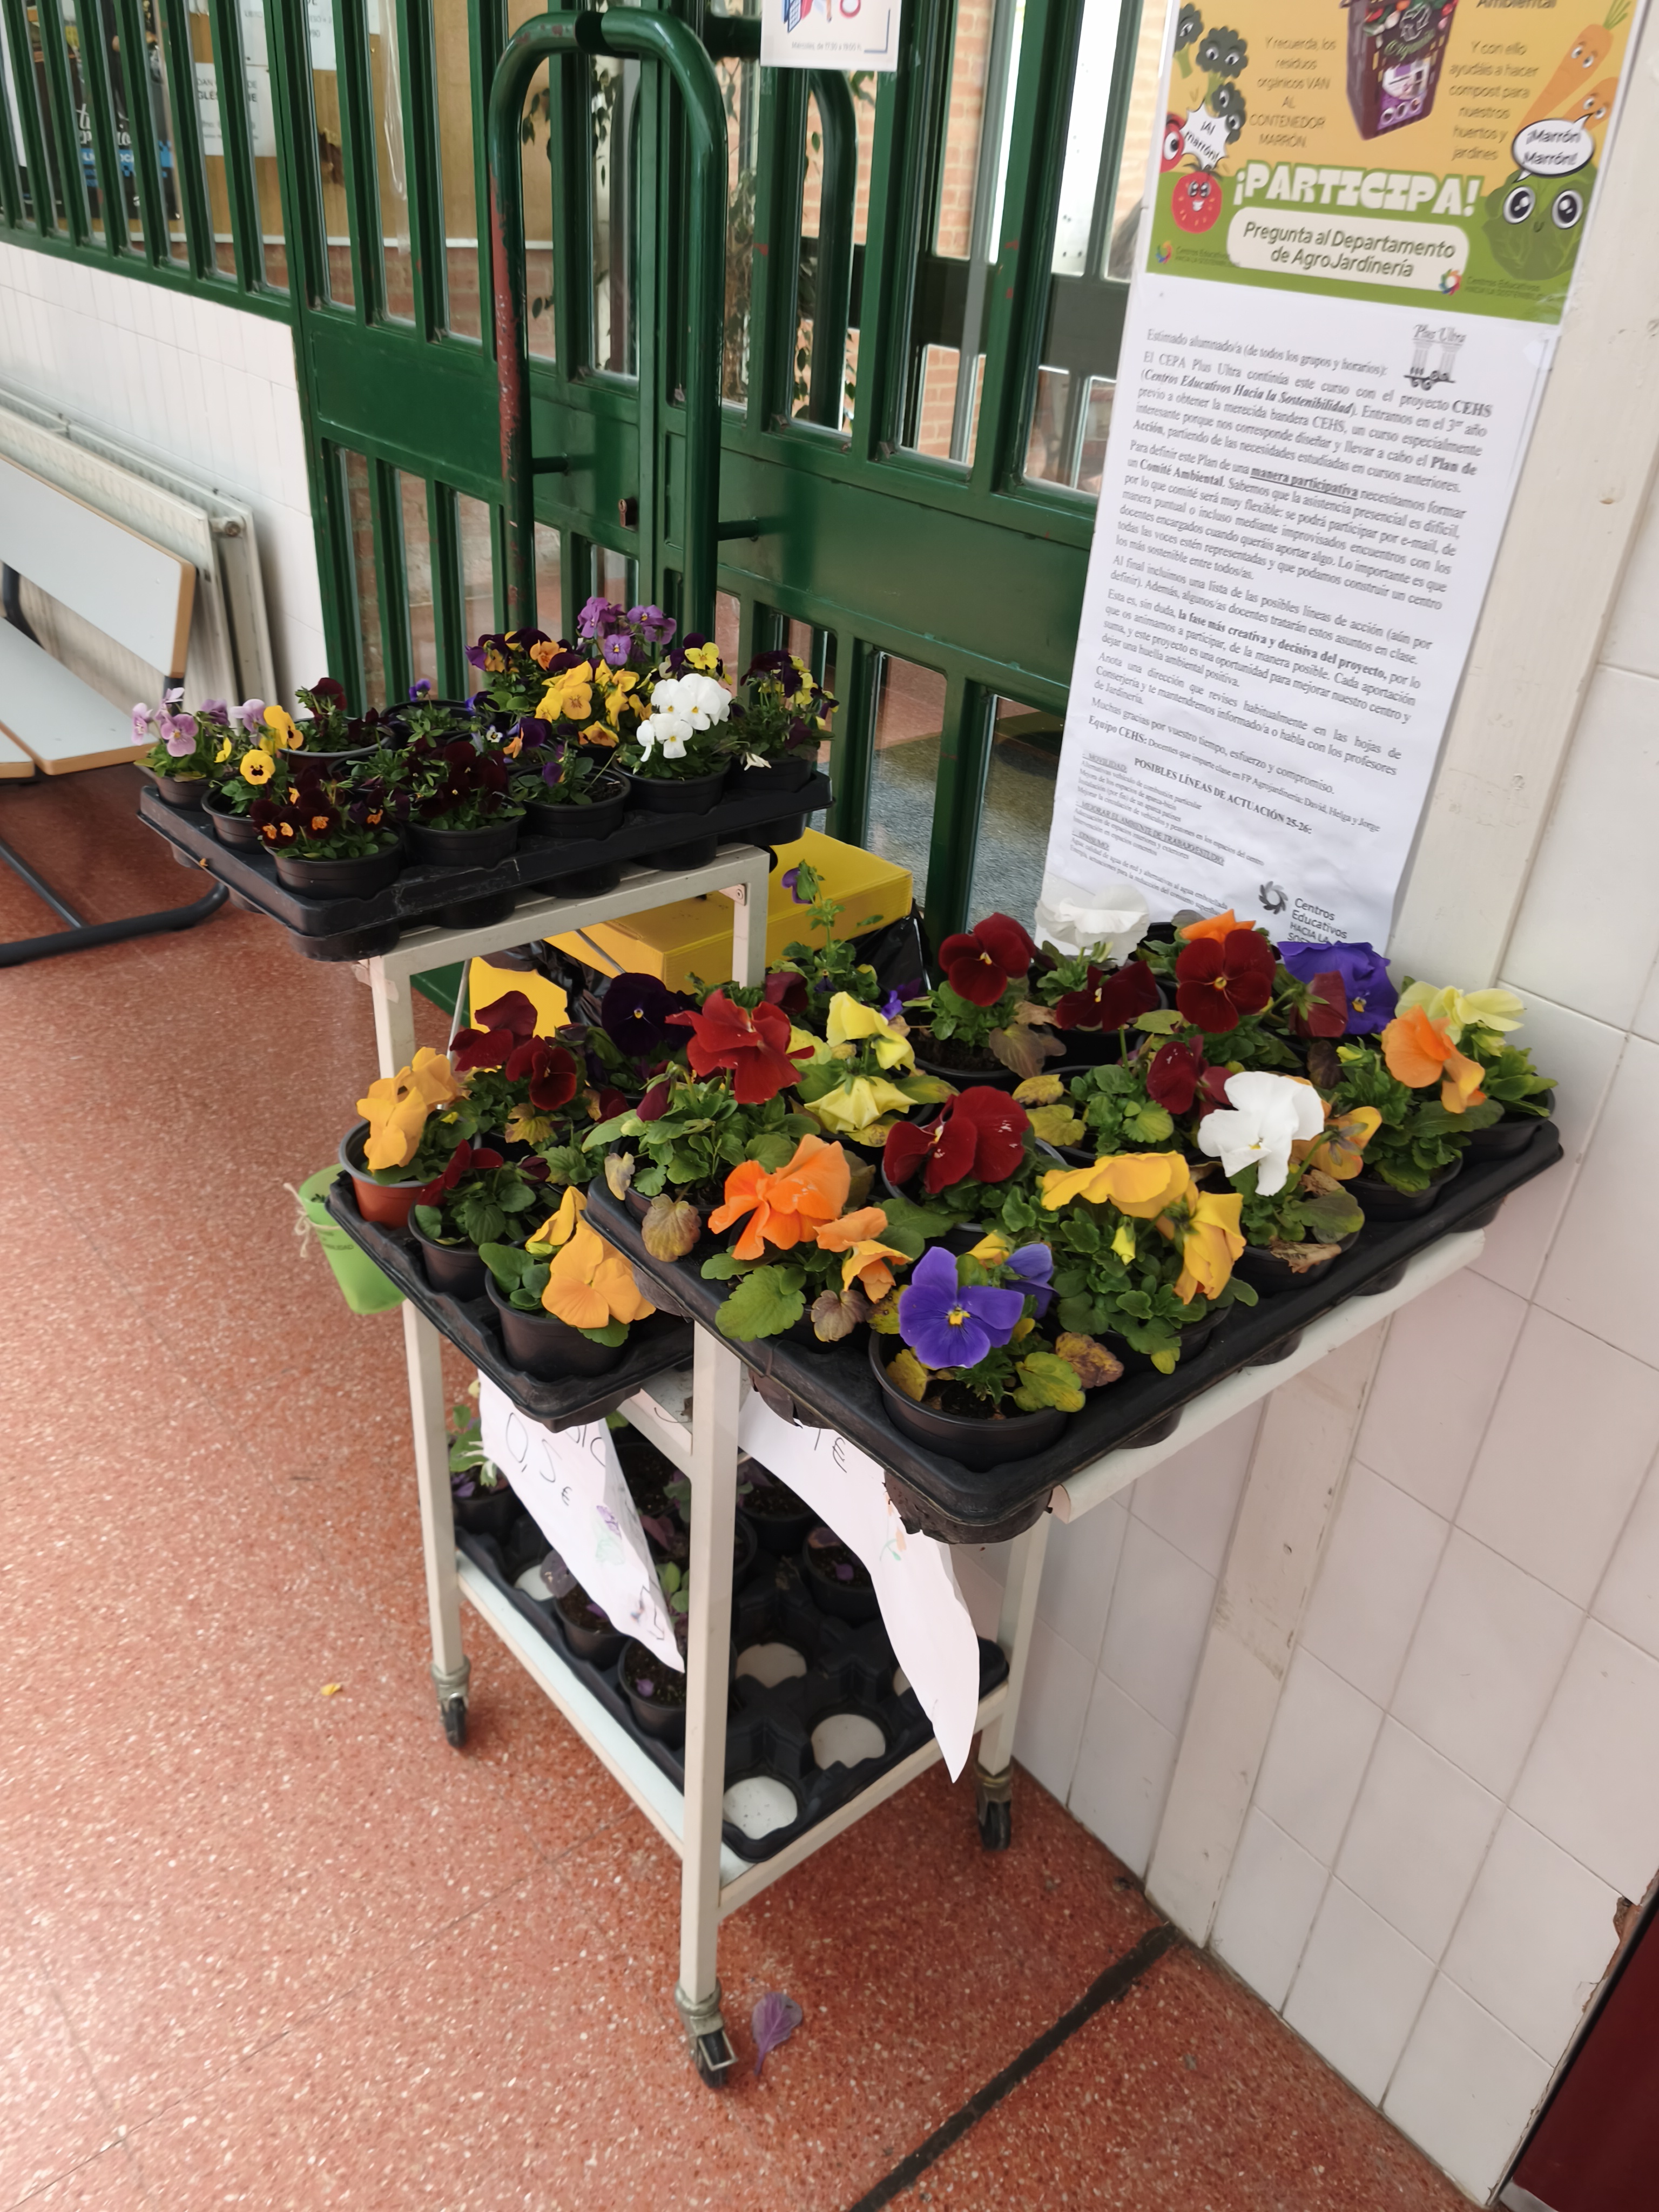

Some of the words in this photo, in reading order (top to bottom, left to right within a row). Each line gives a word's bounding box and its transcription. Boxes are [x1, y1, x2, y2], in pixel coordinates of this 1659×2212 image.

[1481, 43, 1503, 55] con
[1504, 64, 1539, 77] hacer
[1306, 77, 1331, 90] VAN
[1449, 85, 1501, 99] compost
[1501, 87, 1530, 100] para
[1281, 96, 1296, 109] AL
[1459, 107, 1510, 119] nuestros
[1249, 113, 1325, 129] CONTENEDOR
[1453, 125, 1498, 139] huertos
[1451, 146, 1500, 161] jardines
[1233, 164, 1481, 217] ¡PARTICIPA!
[1243, 221, 1313, 245] Pregunta
[1314, 228, 1332, 246] al
[1331, 230, 1456, 259] Departamento
[1271, 245, 1290, 264] de
[1291, 248, 1415, 278] AgroJardinería
[1413, 323, 1436, 340] Plus
[1143, 350, 1155, 363] El
[1158, 353, 1186, 368] CEPA
[1191, 358, 1212, 373] Plus
[1217, 362, 1242, 378] Ultra
[1246, 370, 1290, 386] continúa
[1294, 378, 1316, 390] este
[1320, 382, 1350, 395] curso
[1355, 388, 1377, 400] con
[1381, 389, 1395, 402] el
[1399, 395, 1450, 411] proyecto
[1451, 400, 1493, 418] CEHS
[1180, 375, 1231, 394] Educativos
[1232, 383, 1265, 400] Hacia
[1264, 388, 1278, 402] la
[1361, 405, 1413, 425] Entramos
[1432, 417, 1446, 430] el
[1464, 423, 1487, 437] año
[1130, 439, 1149, 454] Para
[1149, 444, 1178, 460] definir
[1178, 453, 1196, 463] este
[1197, 454, 1218, 468] Plan
[1218, 458, 1232, 471] de
[1232, 464, 1250, 475] una
[1250, 468, 1290, 486] manera
[1290, 476, 1359, 500] participativa
[1360, 490, 1425, 511] necesitamos
[1427, 501, 1467, 519] formar
[1108, 588, 1125, 602] Esta
[1139, 598, 1152, 610] sin
[1178, 609, 1188, 621] la
[1188, 612, 1207, 626] fase
[1207, 621, 1226, 632] más
[1228, 627, 1267, 644] creativa
[1277, 639, 1318, 659] decisiva
[1319, 651, 1338, 664] del
[1388, 673, 1409, 685] por
[1409, 676, 1421, 689] lo
[1092, 697, 1122, 715] Muchas
[1122, 710, 1150, 726] gracias
[1150, 720, 1166, 731] por
[1168, 726, 1198, 743] vuestro
[1229, 750, 1267, 769] esfuerzo
[1134, 758, 1177, 780] POSIBLES
[1178, 773, 1212, 793] LÍNEAS
[1213, 787, 1226, 800] DE
[1227, 794, 1285, 822] ACTUACIÓN
[1294, 898, 1336, 921] Centros
[1290, 921, 1317, 940] HACIA
[1292, 909, 1348, 939] Educativos
